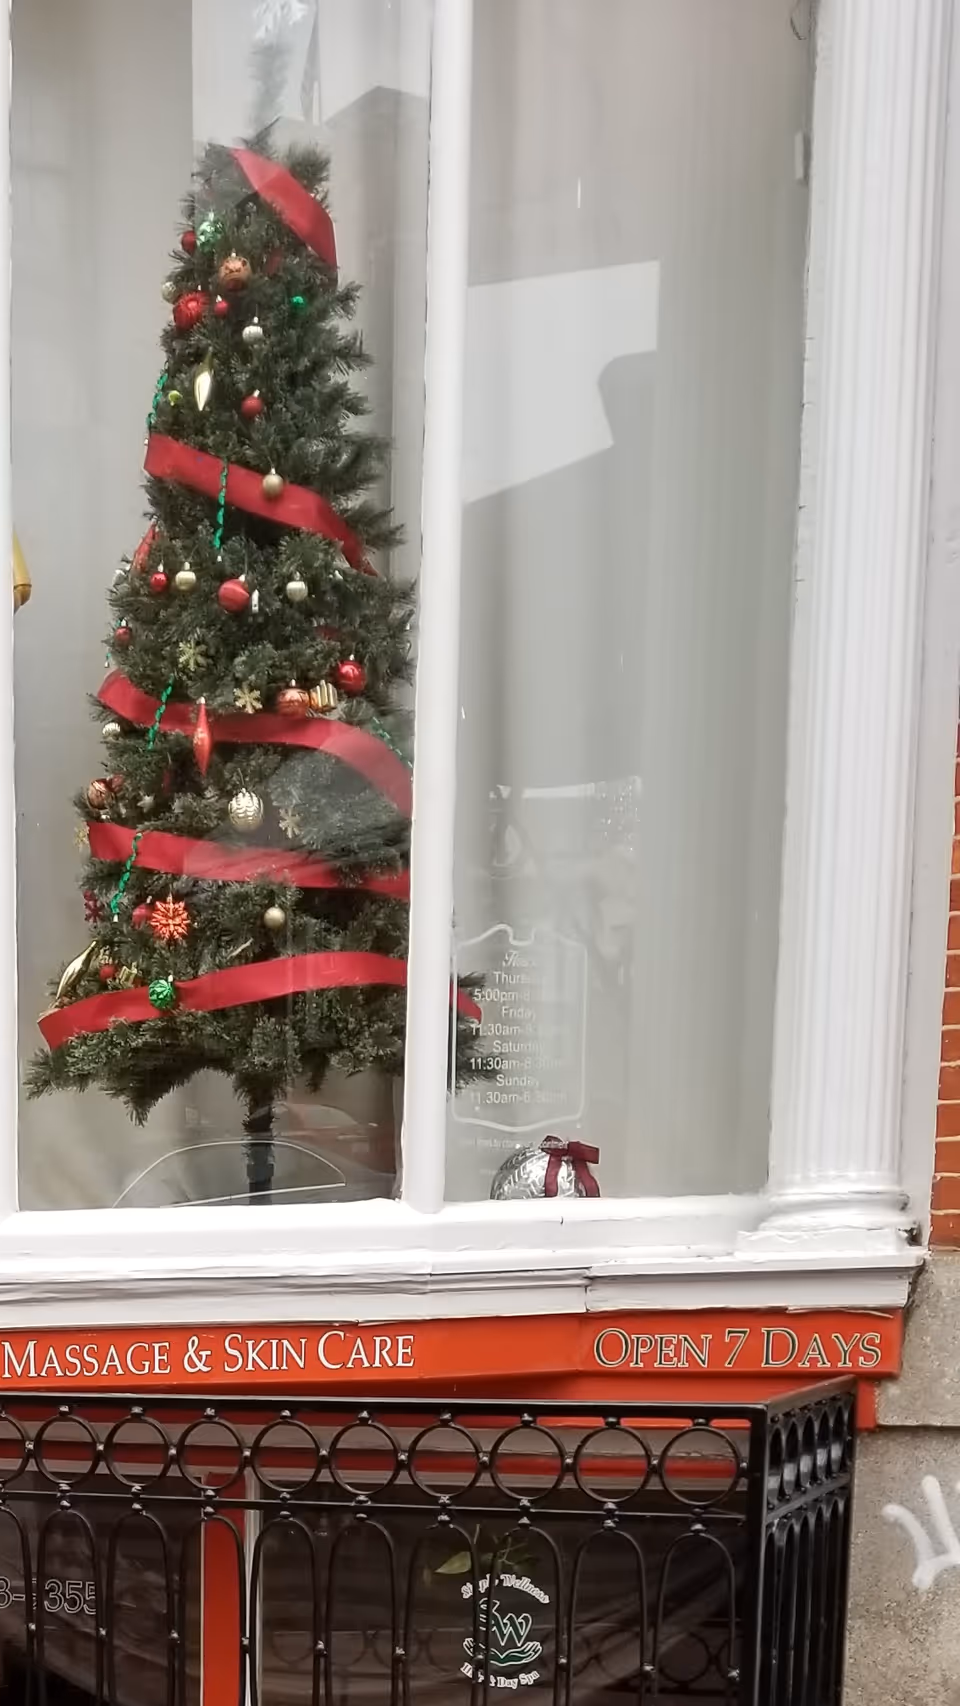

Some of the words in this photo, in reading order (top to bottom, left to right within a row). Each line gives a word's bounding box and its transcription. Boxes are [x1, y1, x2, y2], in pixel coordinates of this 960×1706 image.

[501, 1006, 537, 1022] Friday
[492, 1040, 546, 1054] Saturday
[496, 1074, 540, 1088] Sunday
[0, 1340, 172, 1379] MASSAGE
[182, 1335, 212, 1373] &
[223, 1333, 308, 1373] SKIN
[316, 1330, 416, 1370] CARE
[593, 1328, 713, 1368] OPEN
[724, 1328, 751, 1368] 7
[761, 1327, 882, 1368] DAYS
[500, 1573, 550, 1604] Wellness
[497, 1676, 519, 1690] Day
[519, 1670, 540, 1685] Spa
